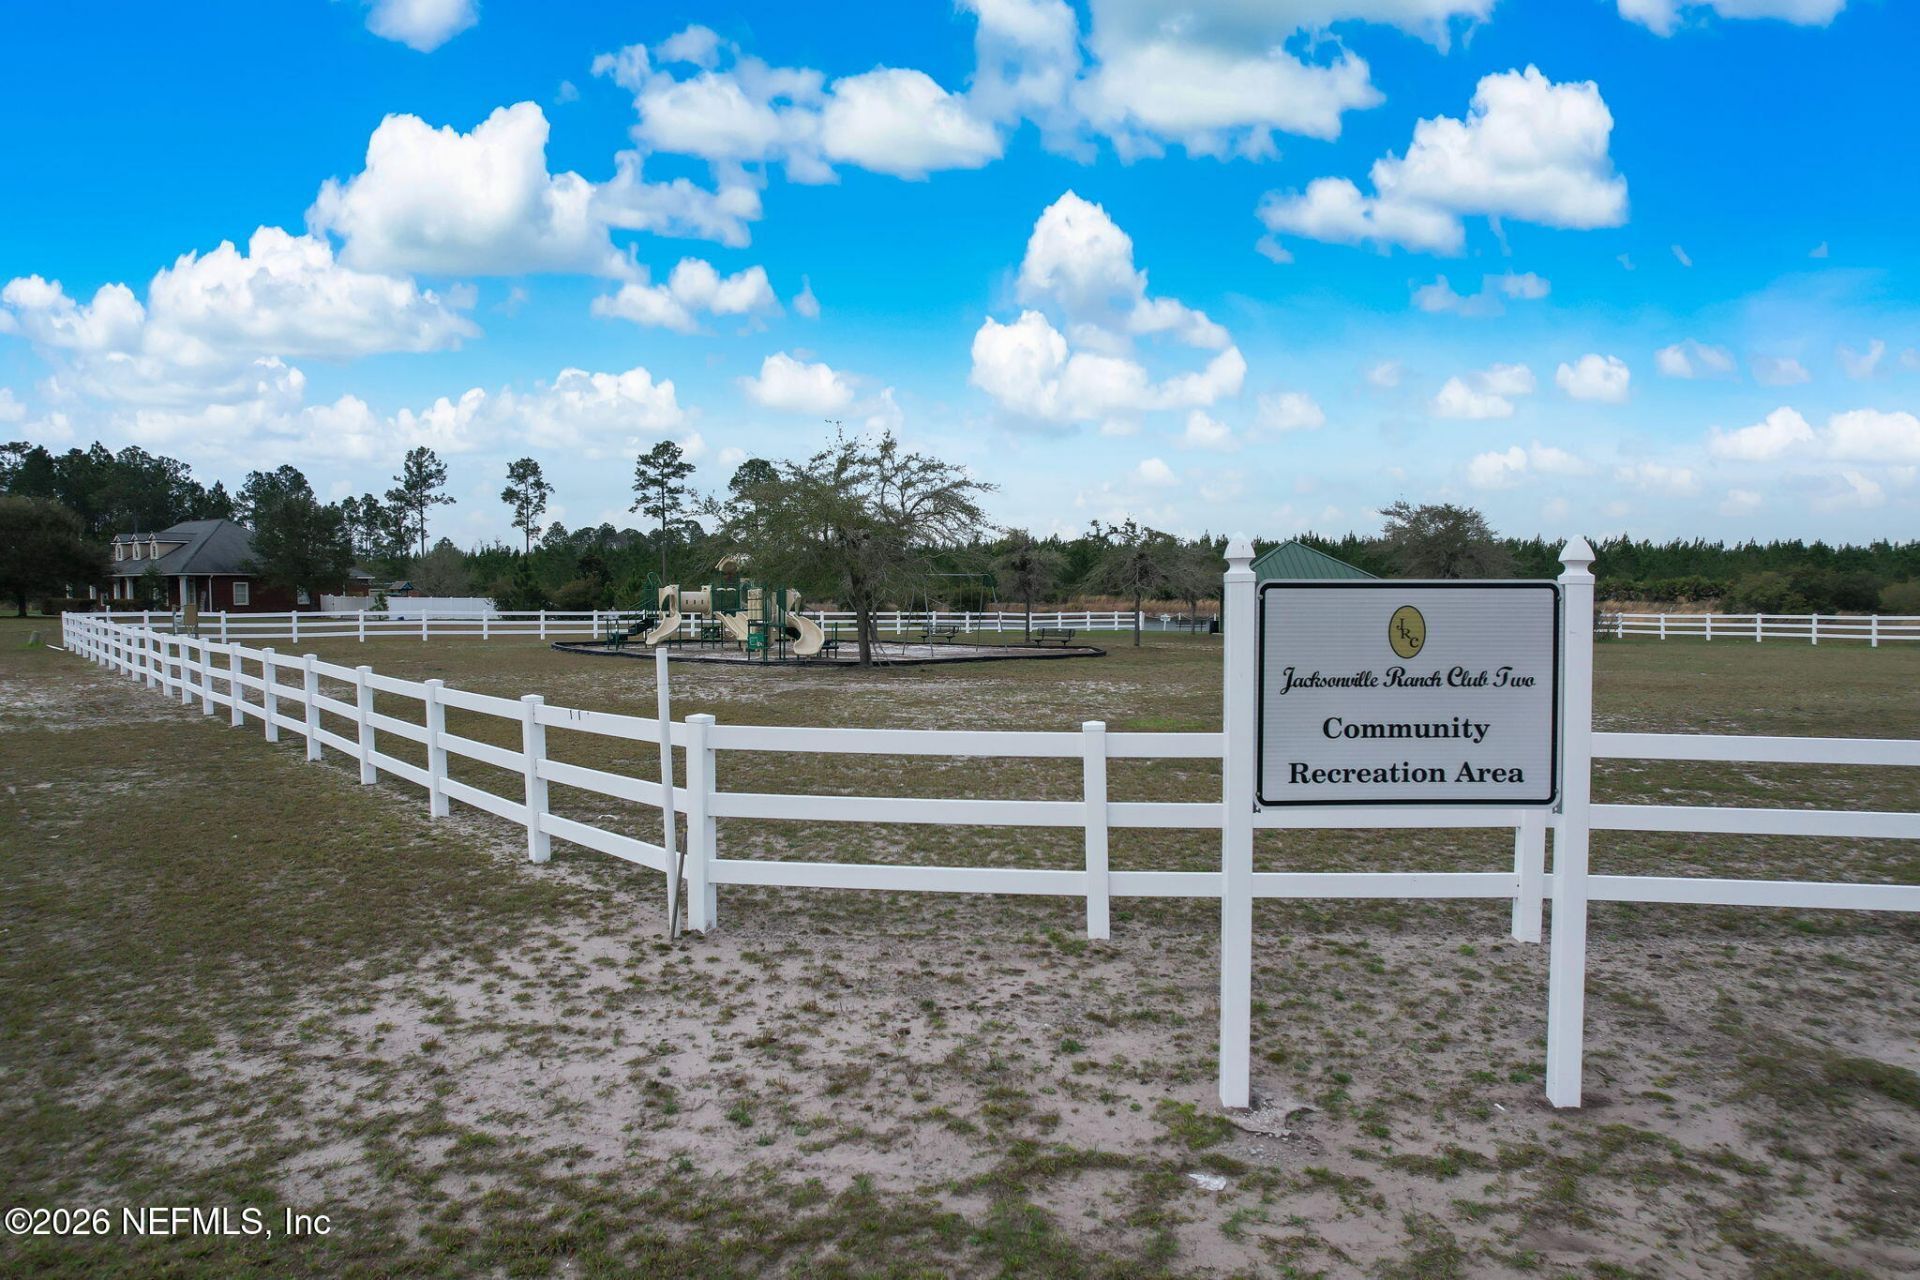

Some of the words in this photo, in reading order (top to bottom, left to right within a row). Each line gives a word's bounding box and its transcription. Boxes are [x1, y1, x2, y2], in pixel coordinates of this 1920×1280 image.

[1280, 667, 1379, 695] Jacksonville
[1382, 666, 1443, 687] Ranch
[1447, 666, 1488, 687] Club
[1491, 666, 1536, 687] Two
[1322, 716, 1490, 743] Community
[1288, 762, 1446, 783] Recreation
[1454, 762, 1525, 783] Area
